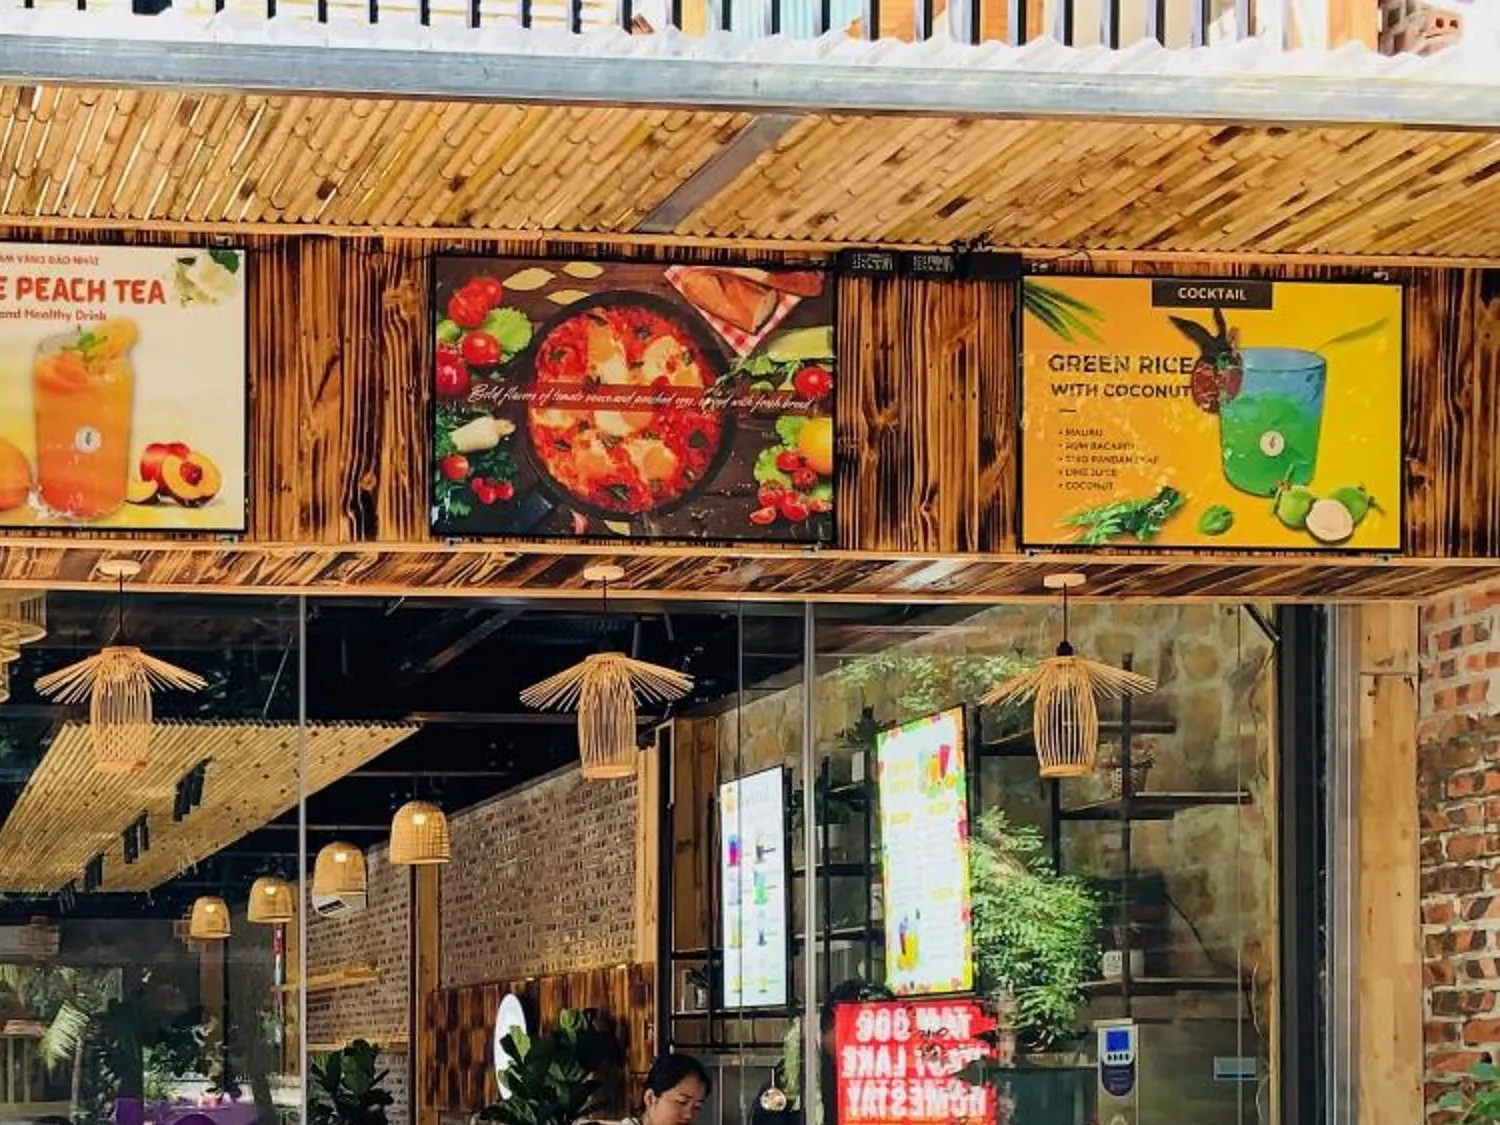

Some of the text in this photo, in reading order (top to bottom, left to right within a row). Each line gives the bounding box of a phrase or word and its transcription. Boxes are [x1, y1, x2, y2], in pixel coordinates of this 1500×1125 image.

[16, 276, 106, 303] PEACH
[114, 278, 166, 304] TEA
[1178, 287, 1247, 300] COCKTAIL
[25, 309, 73, 322] Healthy
[75, 309, 107, 321] Drink
[1048, 353, 1193, 374] GREEN RICE
[1051, 383, 1192, 398] WITH COCONUT
[1065, 481, 1114, 490] COCONUT
